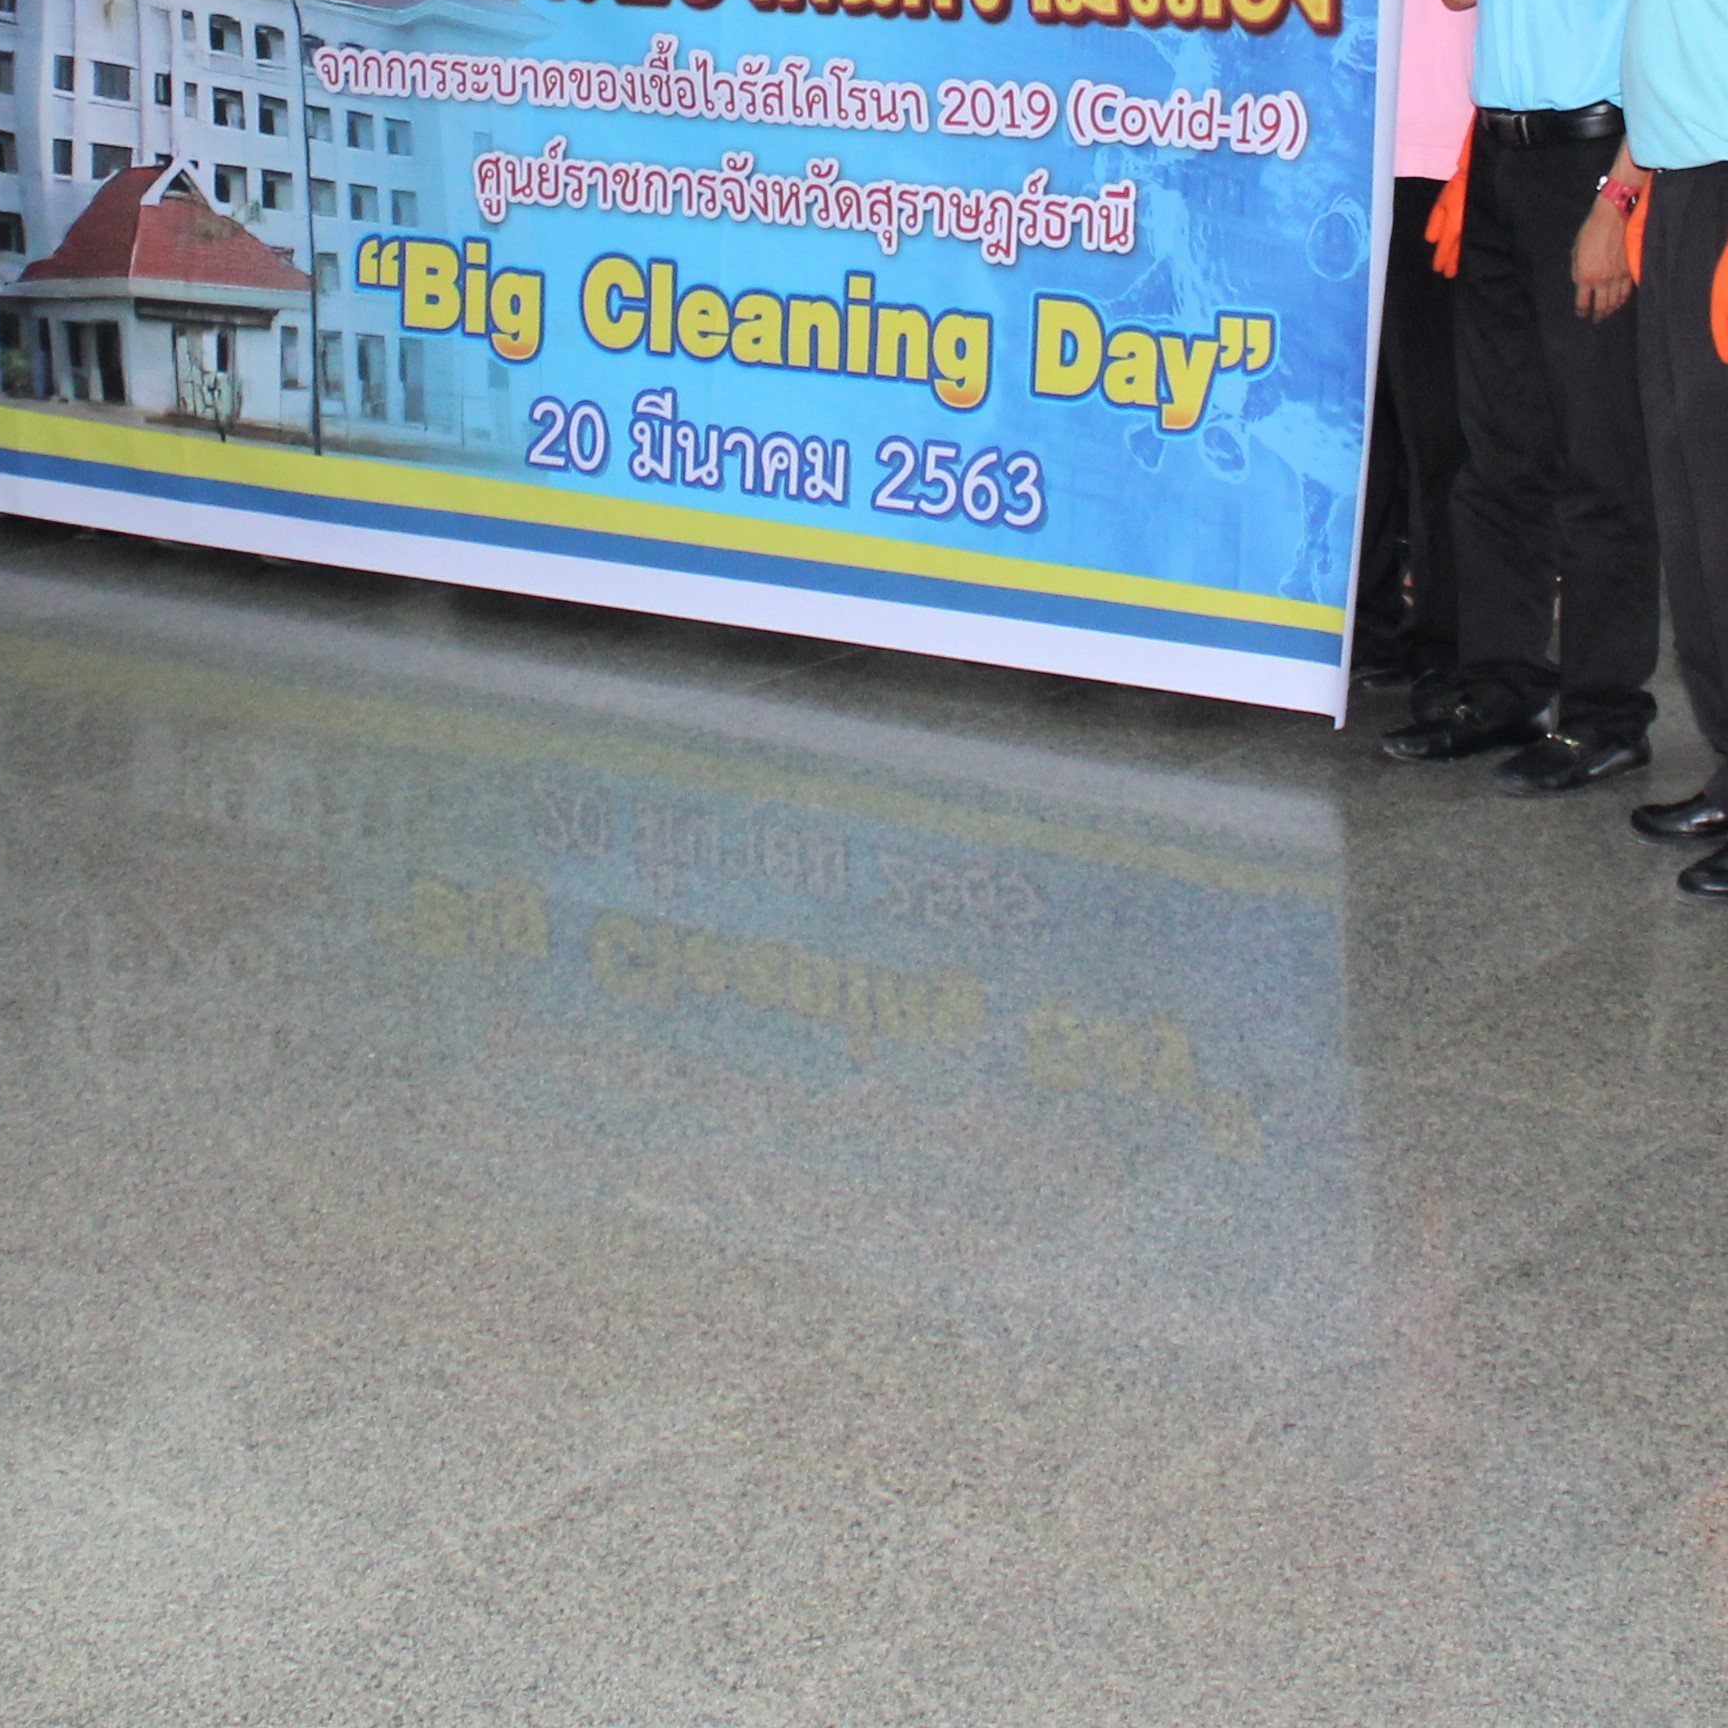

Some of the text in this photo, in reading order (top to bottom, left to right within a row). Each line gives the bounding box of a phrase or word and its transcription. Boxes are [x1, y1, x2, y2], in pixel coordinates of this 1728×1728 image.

[316, 37, 1308, 162] จากการระบาดของเชื้อไวรัสโคโรนา 2019 (Covid-19)
[474, 136, 1139, 265] ศูนย์ราชการจังหวัดสุราษฎร์ธานี
[356, 235, 1277, 433] “Big Cleaning Day”
[528, 388, 1045, 528] 20 มีนาคม 2563
